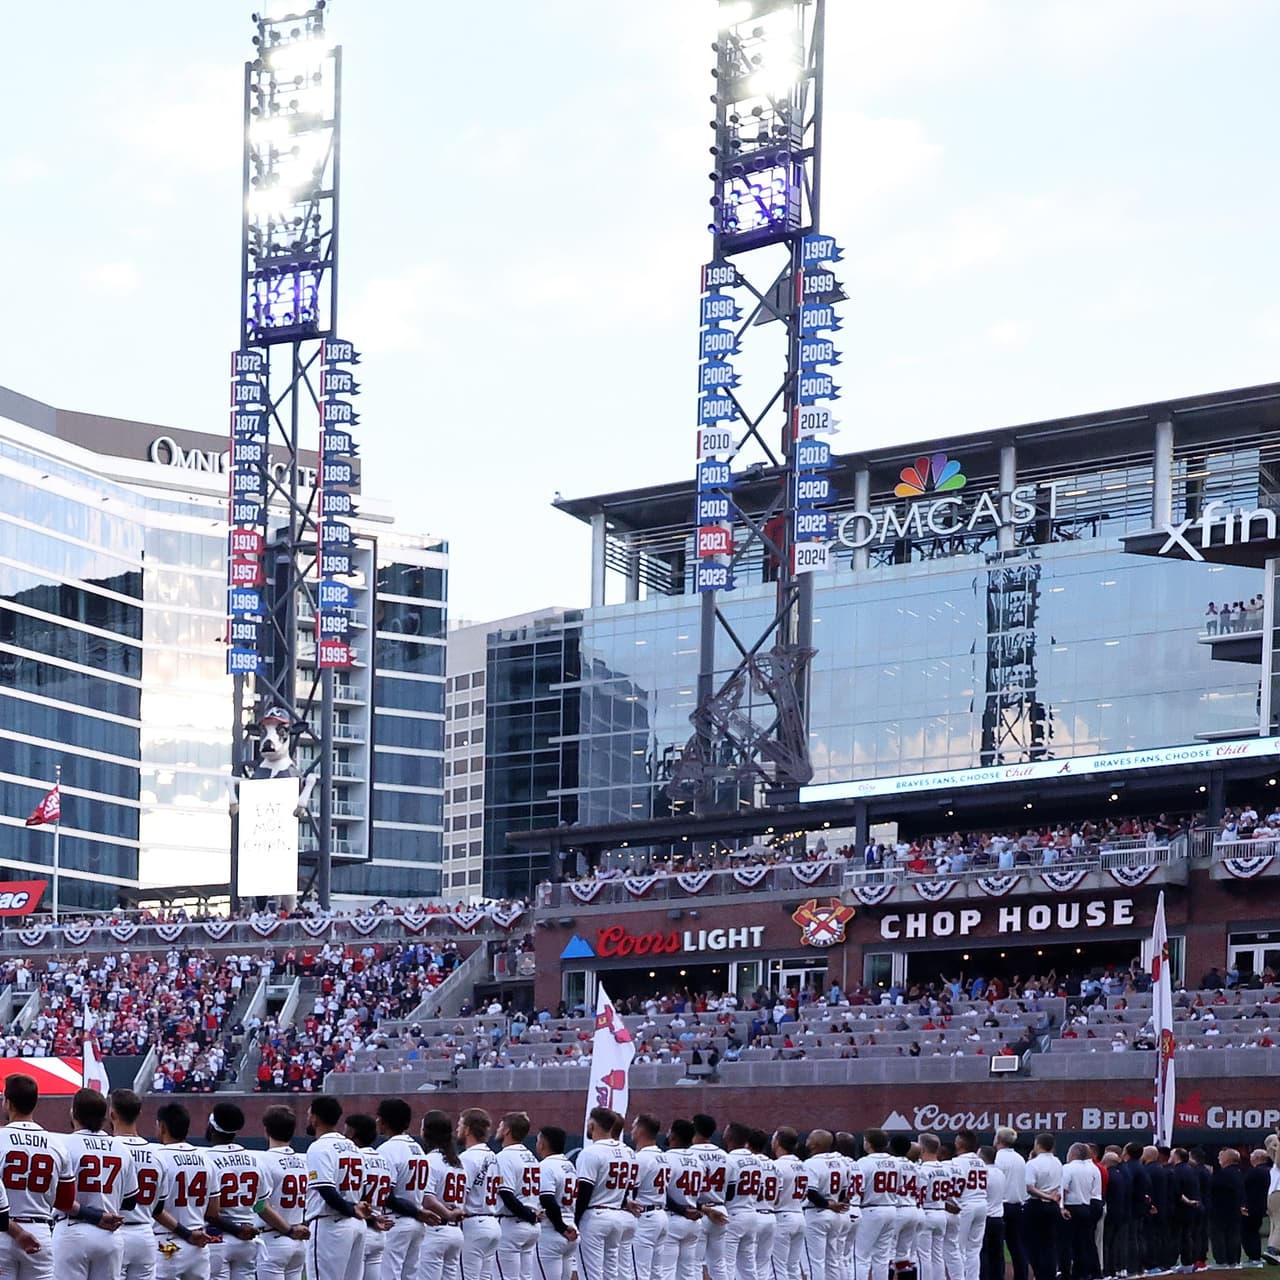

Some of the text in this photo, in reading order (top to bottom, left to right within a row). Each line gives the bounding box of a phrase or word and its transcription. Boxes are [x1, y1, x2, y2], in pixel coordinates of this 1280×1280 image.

[805, 240, 833, 259] 1997
[706, 266, 734, 284] 1996
[804, 275, 833, 293] 1999
[706, 300, 733, 318] 1998
[803, 309, 832, 327] 2001
[705, 333, 733, 351] 2000
[326, 344, 351, 359] 1873
[802, 343, 832, 361] 2003
[236, 356, 261, 370] 1872
[326, 375, 351, 389] 1875
[704, 366, 732, 384] 2002
[236, 386, 260, 400] 1874
[802, 378, 832, 396] 2005
[325, 405, 350, 420] 1878
[704, 400, 732, 418] 2004
[236, 416, 260, 430] 1877
[801, 412, 828, 430] 2012
[325, 435, 349, 450] 1891
[703, 433, 729, 450] 2010
[235, 445, 260, 460] 1883
[800, 447, 828, 464] 2018
[324, 466, 350, 481] 1893
[702, 467, 729, 484] 2013
[235, 475, 260, 490] 1892
[799, 481, 828, 498] 2020
[323, 496, 350, 511] 1898
[701, 500, 728, 517] 2019
[234, 505, 259, 520] 1897
[826, 481, 1069, 550] OMCAST
[798, 515, 827, 532] 2022
[234, 535, 257, 550] 1914
[323, 527, 349, 541] 1948
[700, 533, 727, 550] 2021
[323, 557, 349, 572] 1958
[798, 549, 826, 565] 2024
[233, 565, 257, 580] 1957
[699, 569, 726, 585] 2023
[233, 594, 258, 609] 1969
[322, 587, 348, 602] 1982
[233, 624, 256, 639] 1991
[322, 617, 347, 632] 1992
[232, 653, 257, 669] 1993
[321, 647, 347, 662] 1995
[1094, 758, 1131, 768] BRAVES
[1165, 750, 1211, 761] CHOOSE
[896, 778, 930, 789] BRAVES
[960, 771, 1000, 783] CHOOSE
[880, 910, 982, 939] CHOP
[999, 899, 1135, 933] HOUSE
[595, 925, 765, 957] Coors LIGHT
[913, 1104, 992, 1131] Coors
[993, 1111, 1067, 1131] LIGHT
[1178, 1112, 1199, 1124] THE
[1206, 1105, 1280, 1129] CHOP
[10, 1133, 48, 1150] OLSON
[83, 1137, 113, 1152] RILEY
[130, 1149, 152, 1164] HITE
[214, 1155, 250, 1170] HARRIS
[3, 1150, 54, 1193] 28
[77, 1156, 122, 1194] 27
[338, 1157, 363, 1191] 75
[405, 1160, 429, 1191] 70
[606, 1162, 629, 1189] 52
[967, 1170, 987, 1189] 95
[175, 1171, 207, 1207] 14
[220, 1171, 259, 1208] 23
[366, 1174, 391, 1207] 72
[443, 1172, 466, 1204] 66
[522, 1168, 540, 1196] 55
[676, 1171, 701, 1196] 40
[737, 1170, 761, 1195] 26
[830, 1171, 841, 1194] 8
[874, 1171, 897, 1193] 80
[280, 1174, 307, 1209] 99
